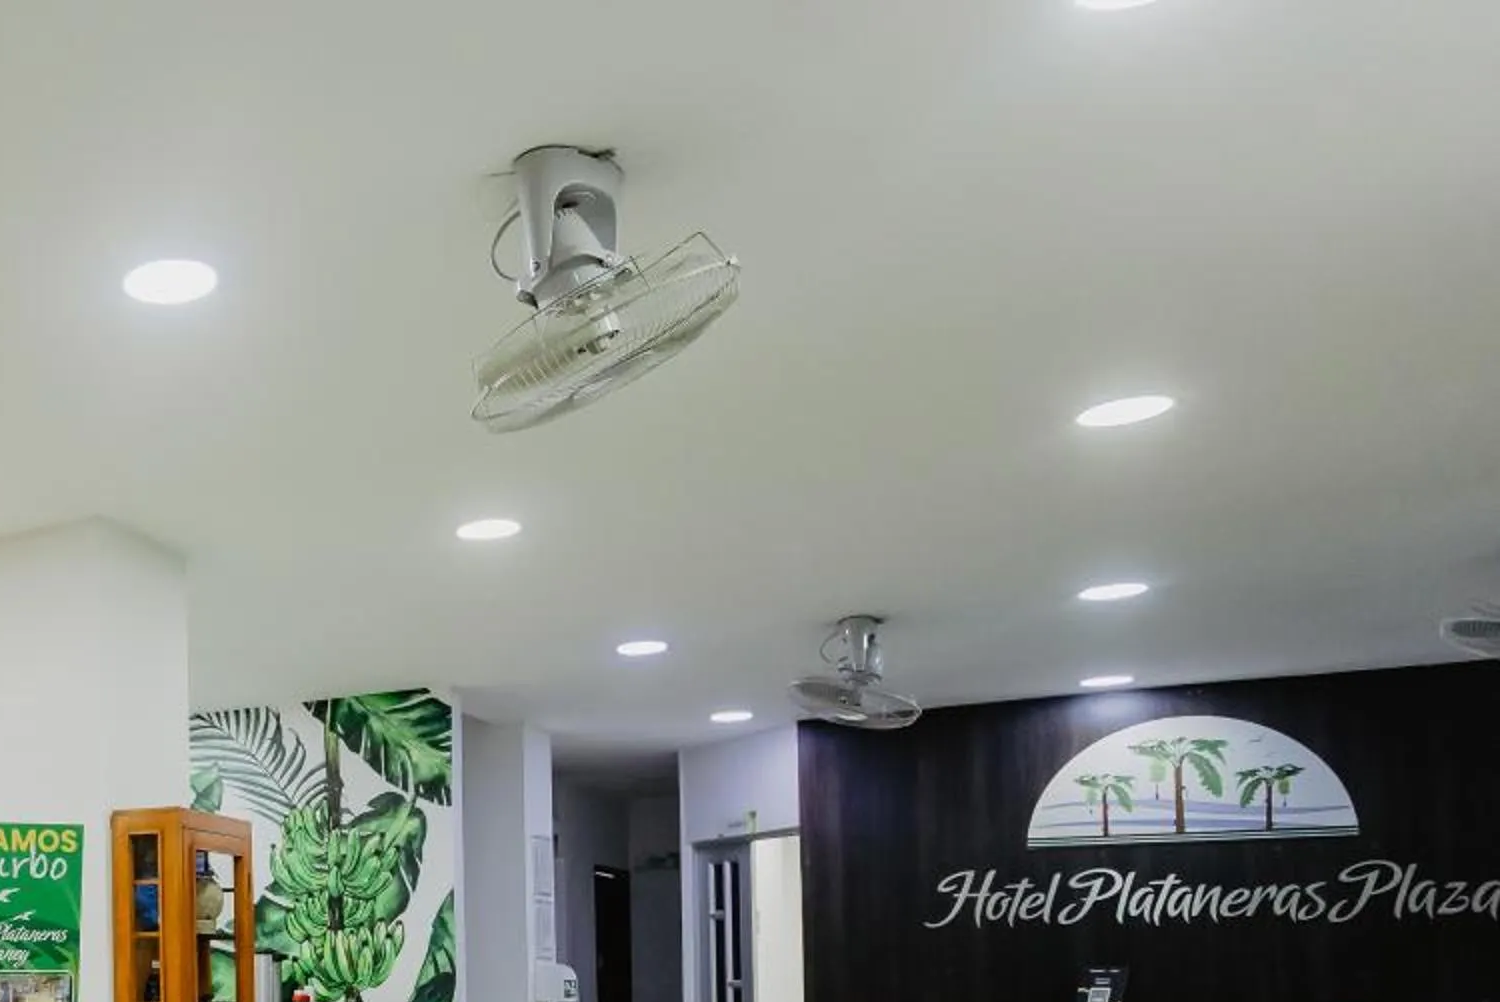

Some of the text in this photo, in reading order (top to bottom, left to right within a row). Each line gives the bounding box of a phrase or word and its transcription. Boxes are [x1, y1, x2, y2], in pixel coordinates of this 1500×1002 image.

[923, 859, 1500, 929] Hotel Plataneras Plaza
